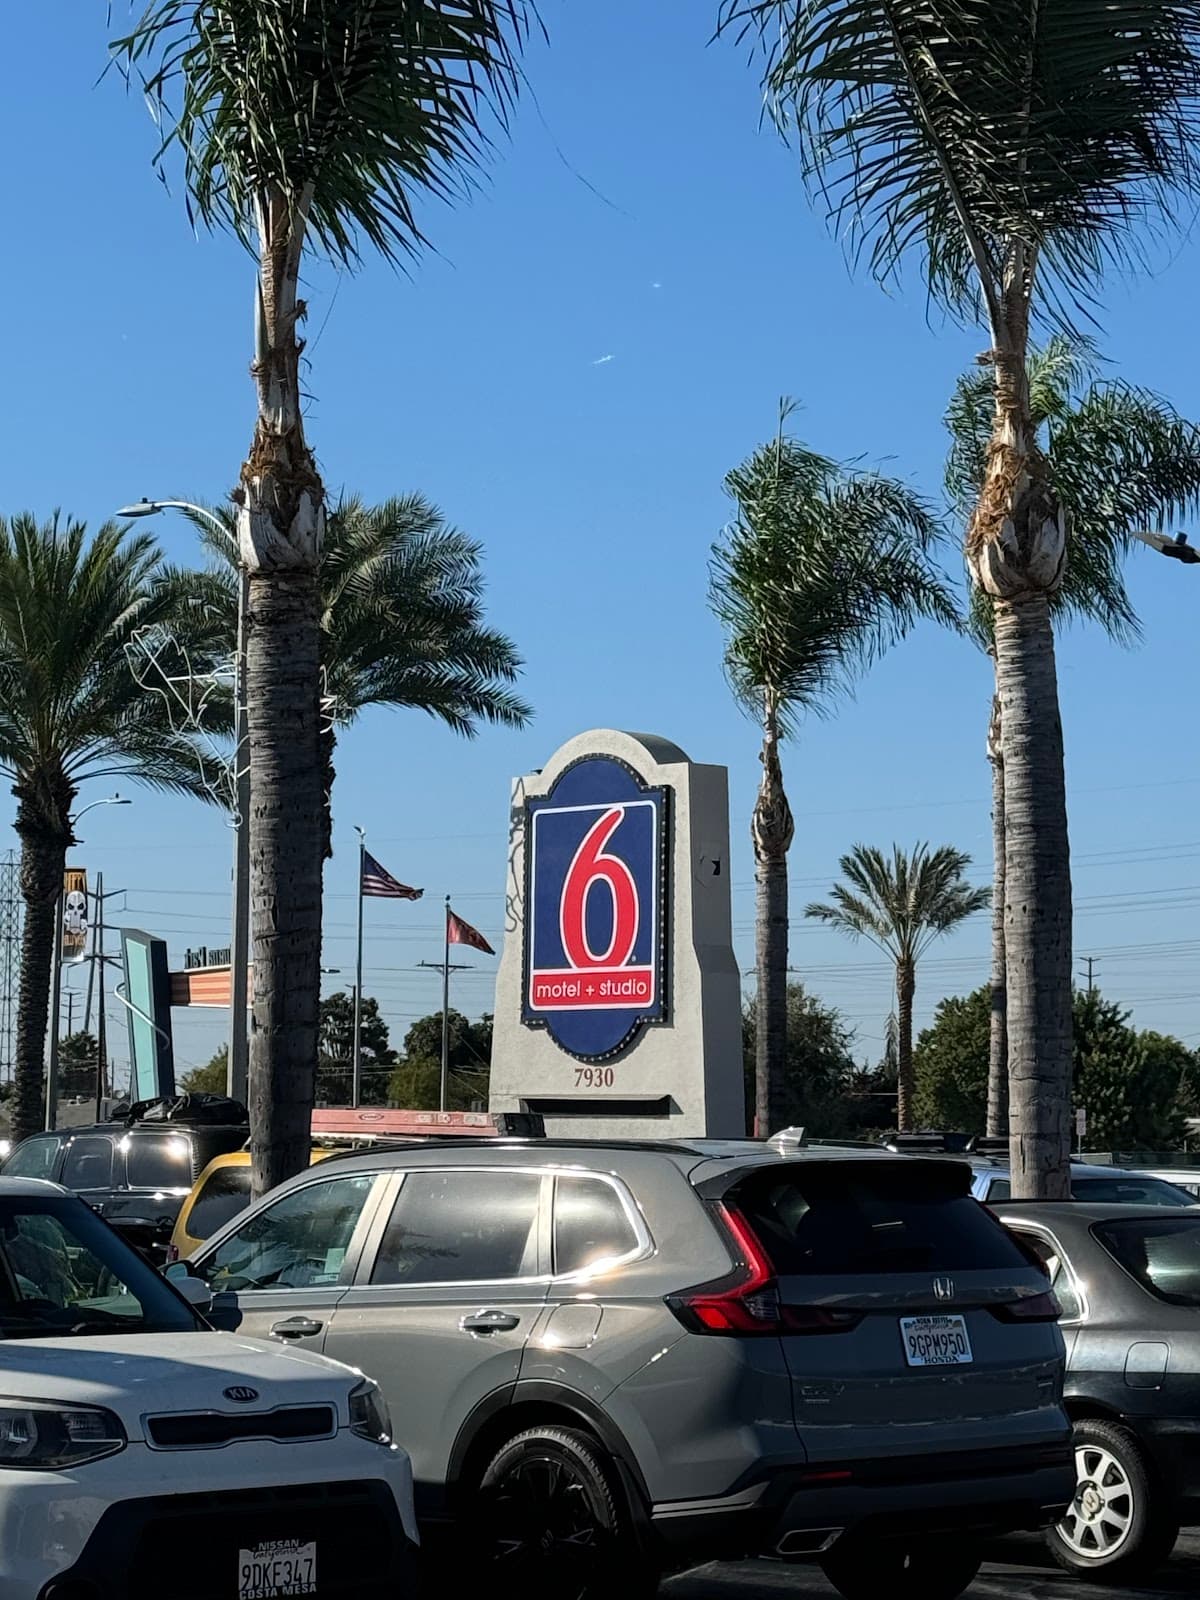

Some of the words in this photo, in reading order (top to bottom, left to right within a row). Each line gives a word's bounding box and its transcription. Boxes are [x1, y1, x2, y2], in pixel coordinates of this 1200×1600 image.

[559, 805, 640, 969] 6
[536, 980, 581, 998] motel
[599, 978, 647, 996] studio
[574, 1068, 615, 1088] 7930
[908, 1333, 966, 1358] 9GPM950
[923, 1354, 959, 1364] HONDA
[229, 1387, 256, 1398] KIA
[258, 1538, 300, 1551] NISSAN
[241, 1558, 313, 1591] 9DKF347
[239, 1585, 278, 1600] COSTA
[283, 1583, 317, 1596] MESA
